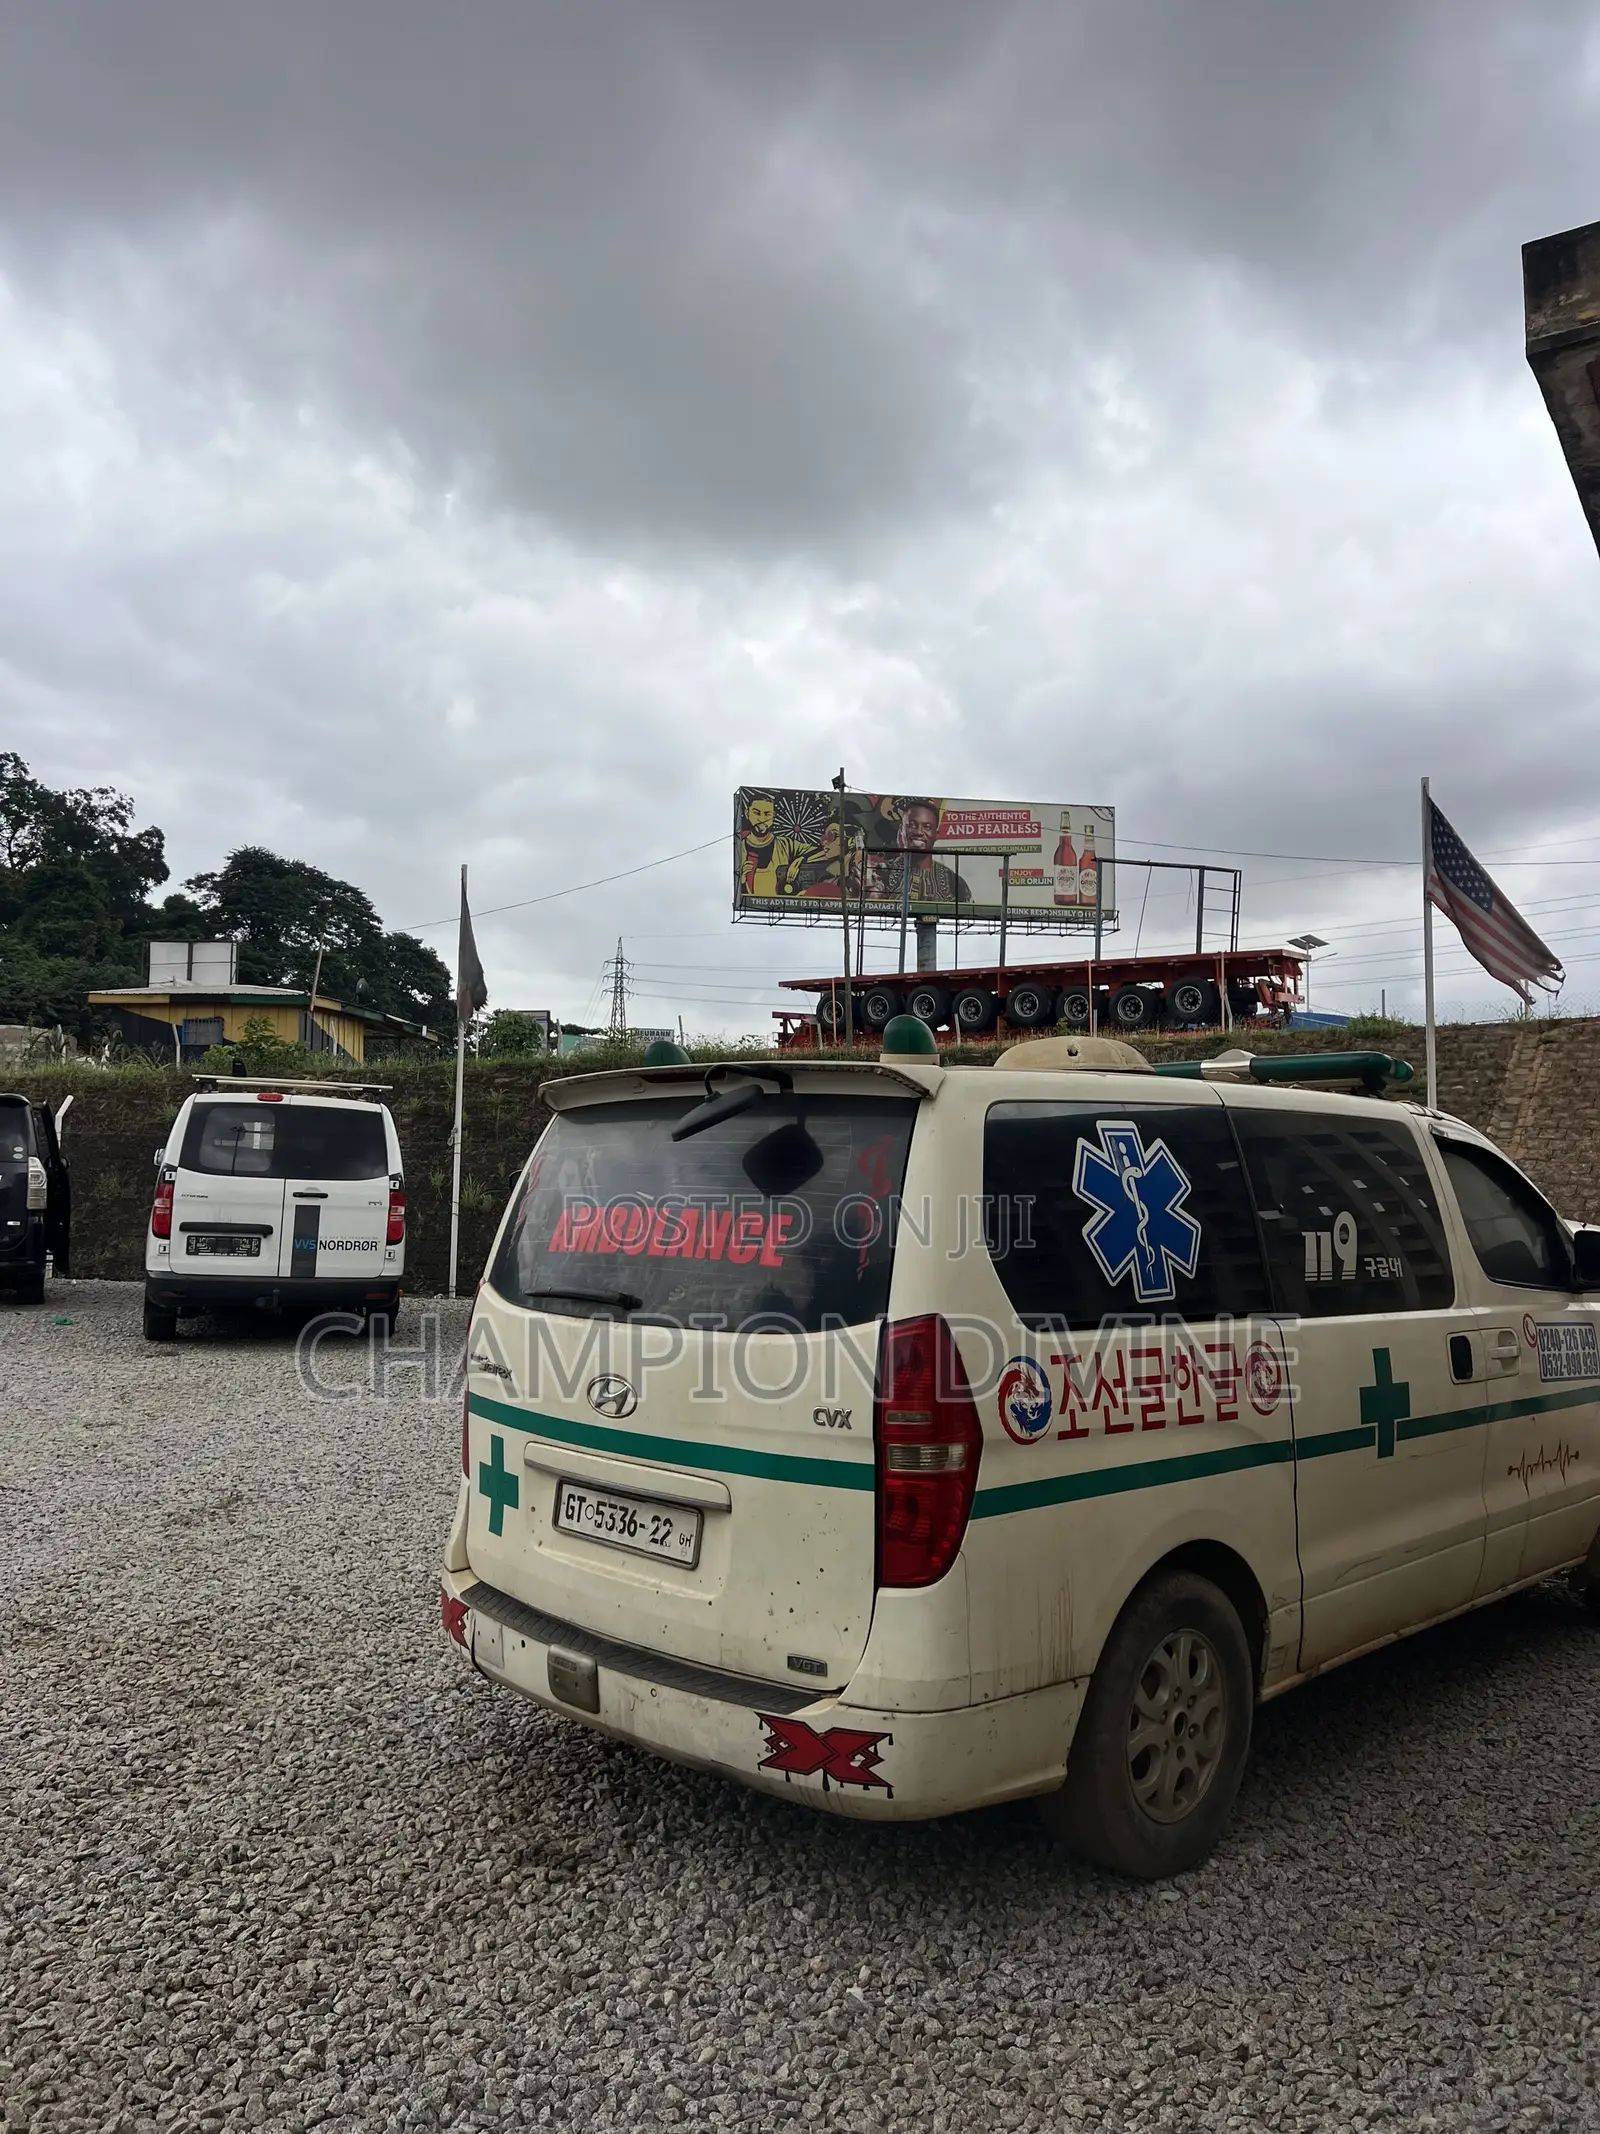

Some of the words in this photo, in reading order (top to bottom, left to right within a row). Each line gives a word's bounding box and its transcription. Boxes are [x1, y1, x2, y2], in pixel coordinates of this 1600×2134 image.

[946, 813, 959, 821] TO
[960, 813, 977, 821] THE
[979, 812, 1028, 821] AUTHENTIC
[946, 824, 975, 836] AND
[977, 823, 1039, 834] FEARLESS
[1026, 877, 1053, 885] ORIJIN
[294, 1239, 317, 1250] VVS
[319, 1240, 378, 1251] NORDRØR
[547, 1206, 794, 1268] AMBULANCE
[1301, 1211, 1358, 1281] 119
[1364, 1257, 1404, 1278] 구급대
[1538, 1328, 1579, 1352] 0240-126
[812, 1406, 852, 1430] CVX
[565, 1493, 587, 1523] GT
